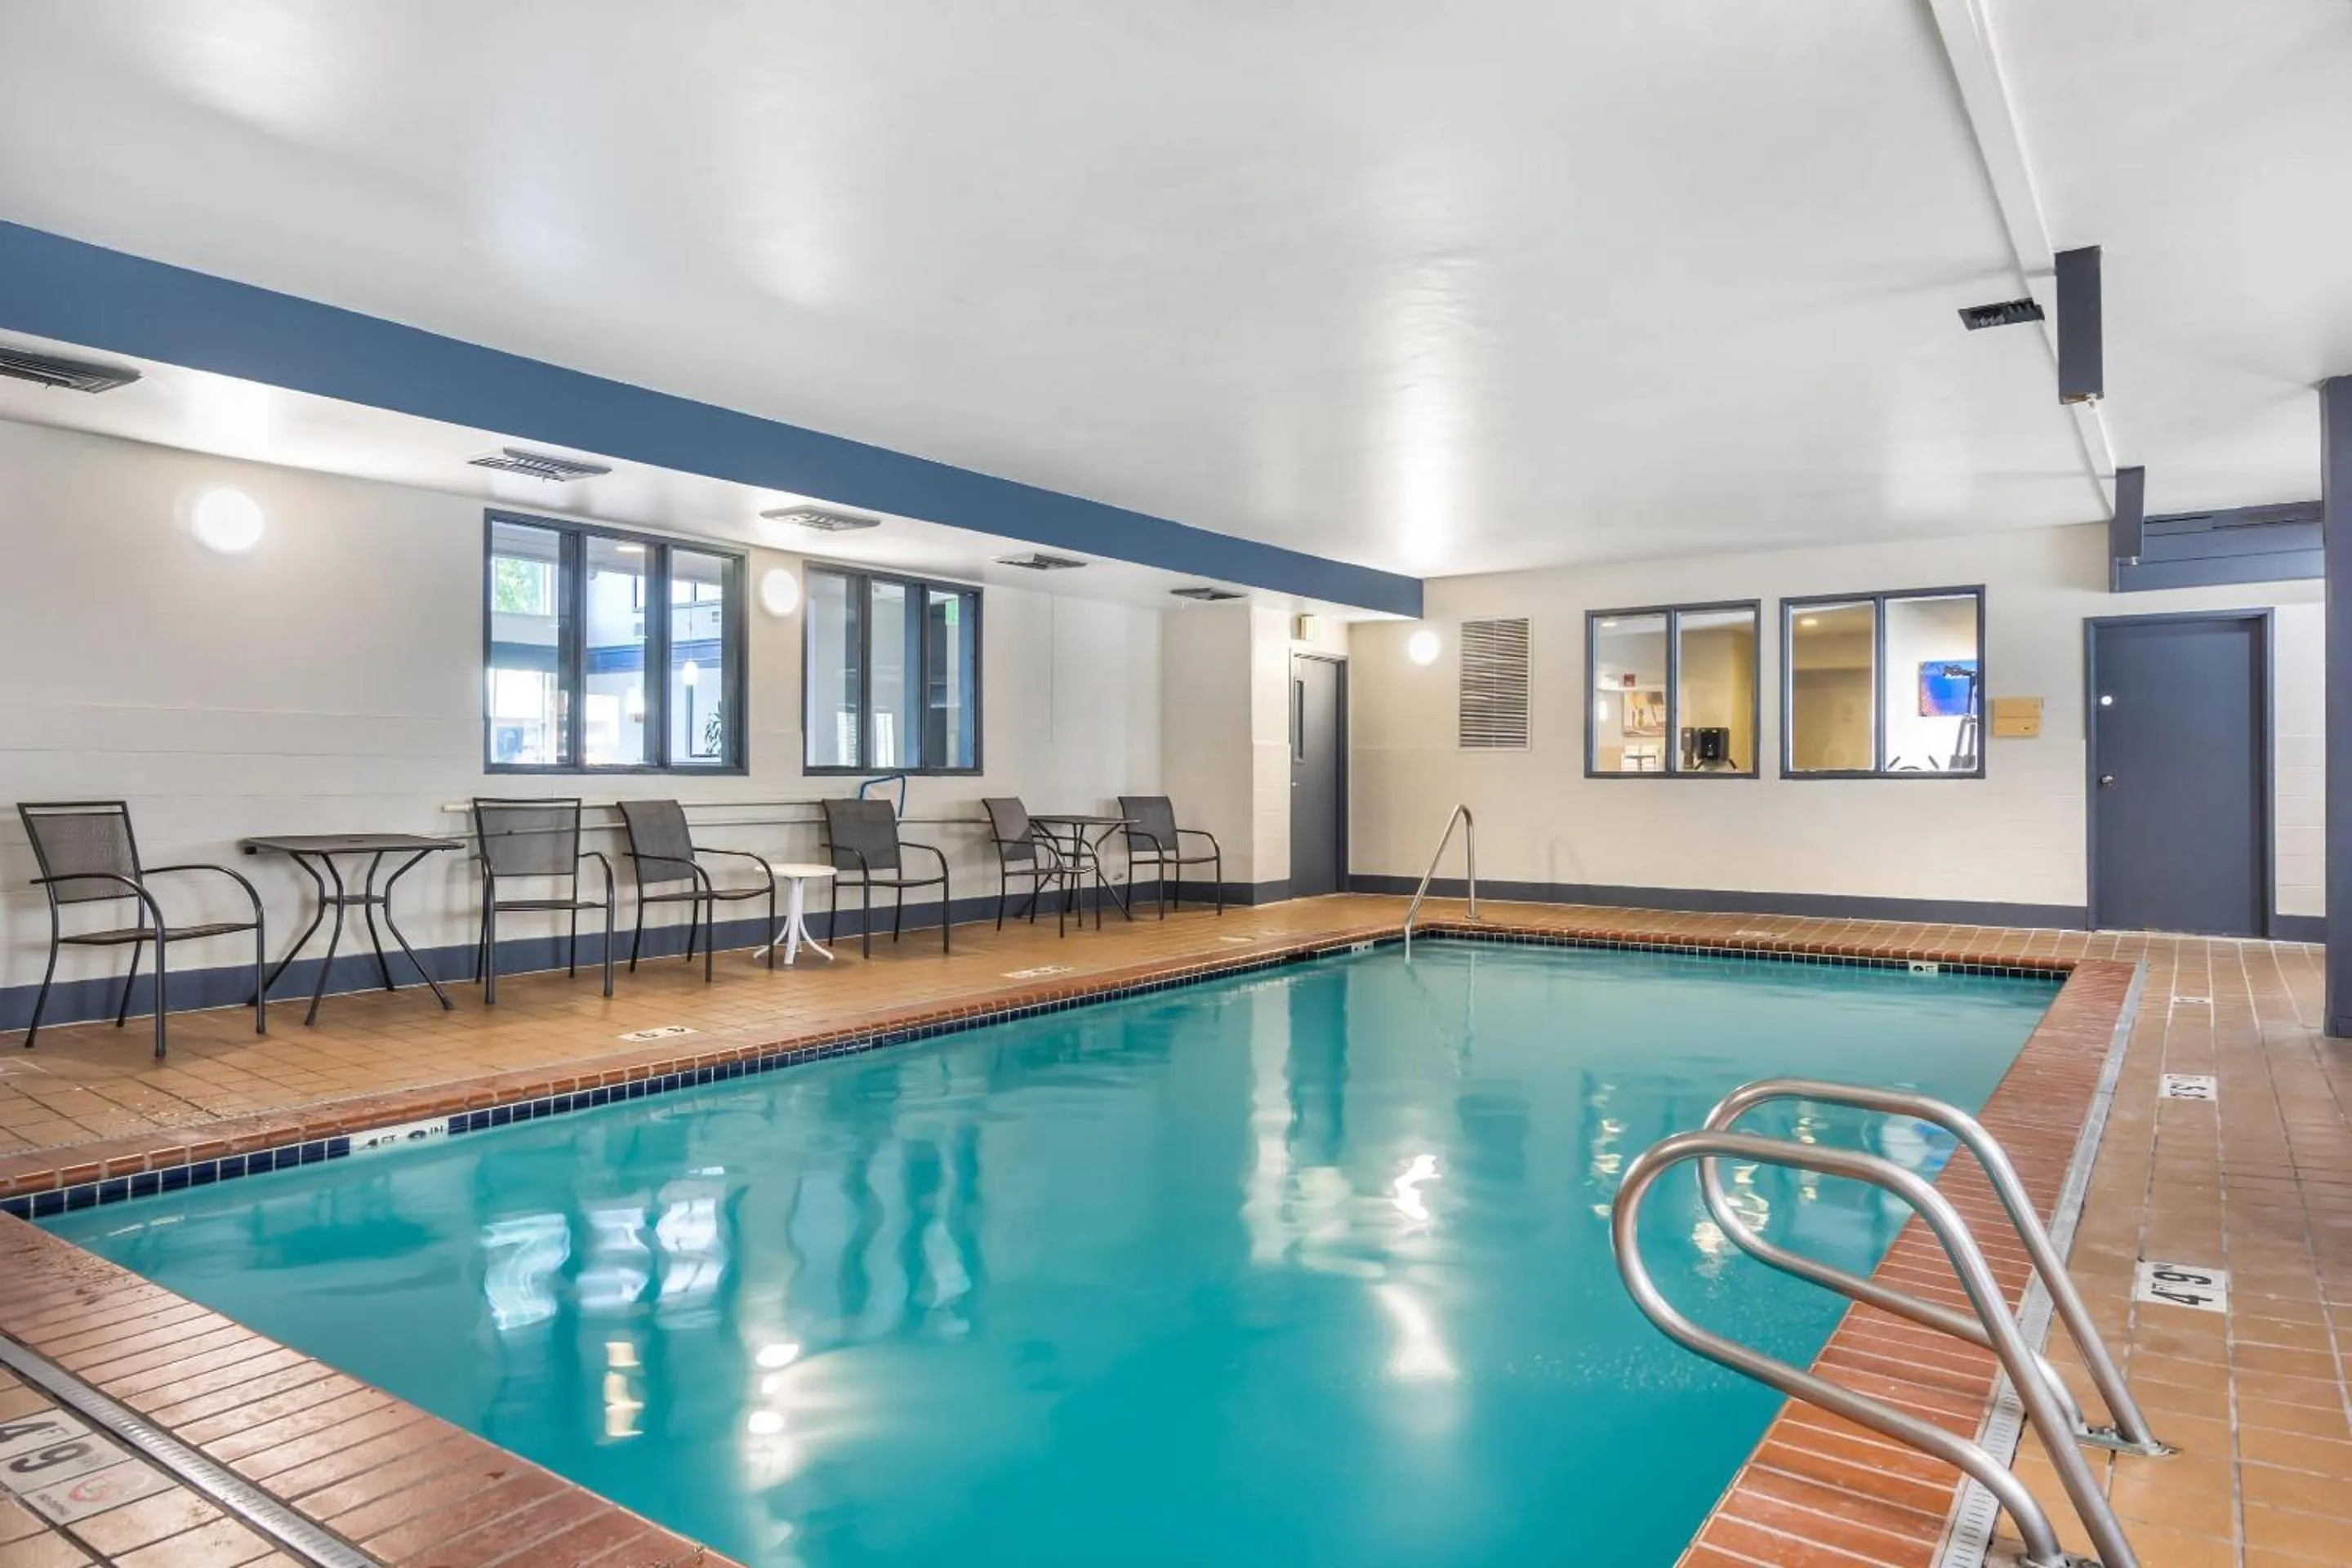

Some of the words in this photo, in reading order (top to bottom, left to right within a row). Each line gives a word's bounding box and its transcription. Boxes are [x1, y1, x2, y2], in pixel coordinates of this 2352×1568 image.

[2152, 1271, 2212, 1285] 9
[2151, 1290, 2213, 1305] 4
[9, 1442, 94, 1473] 9
